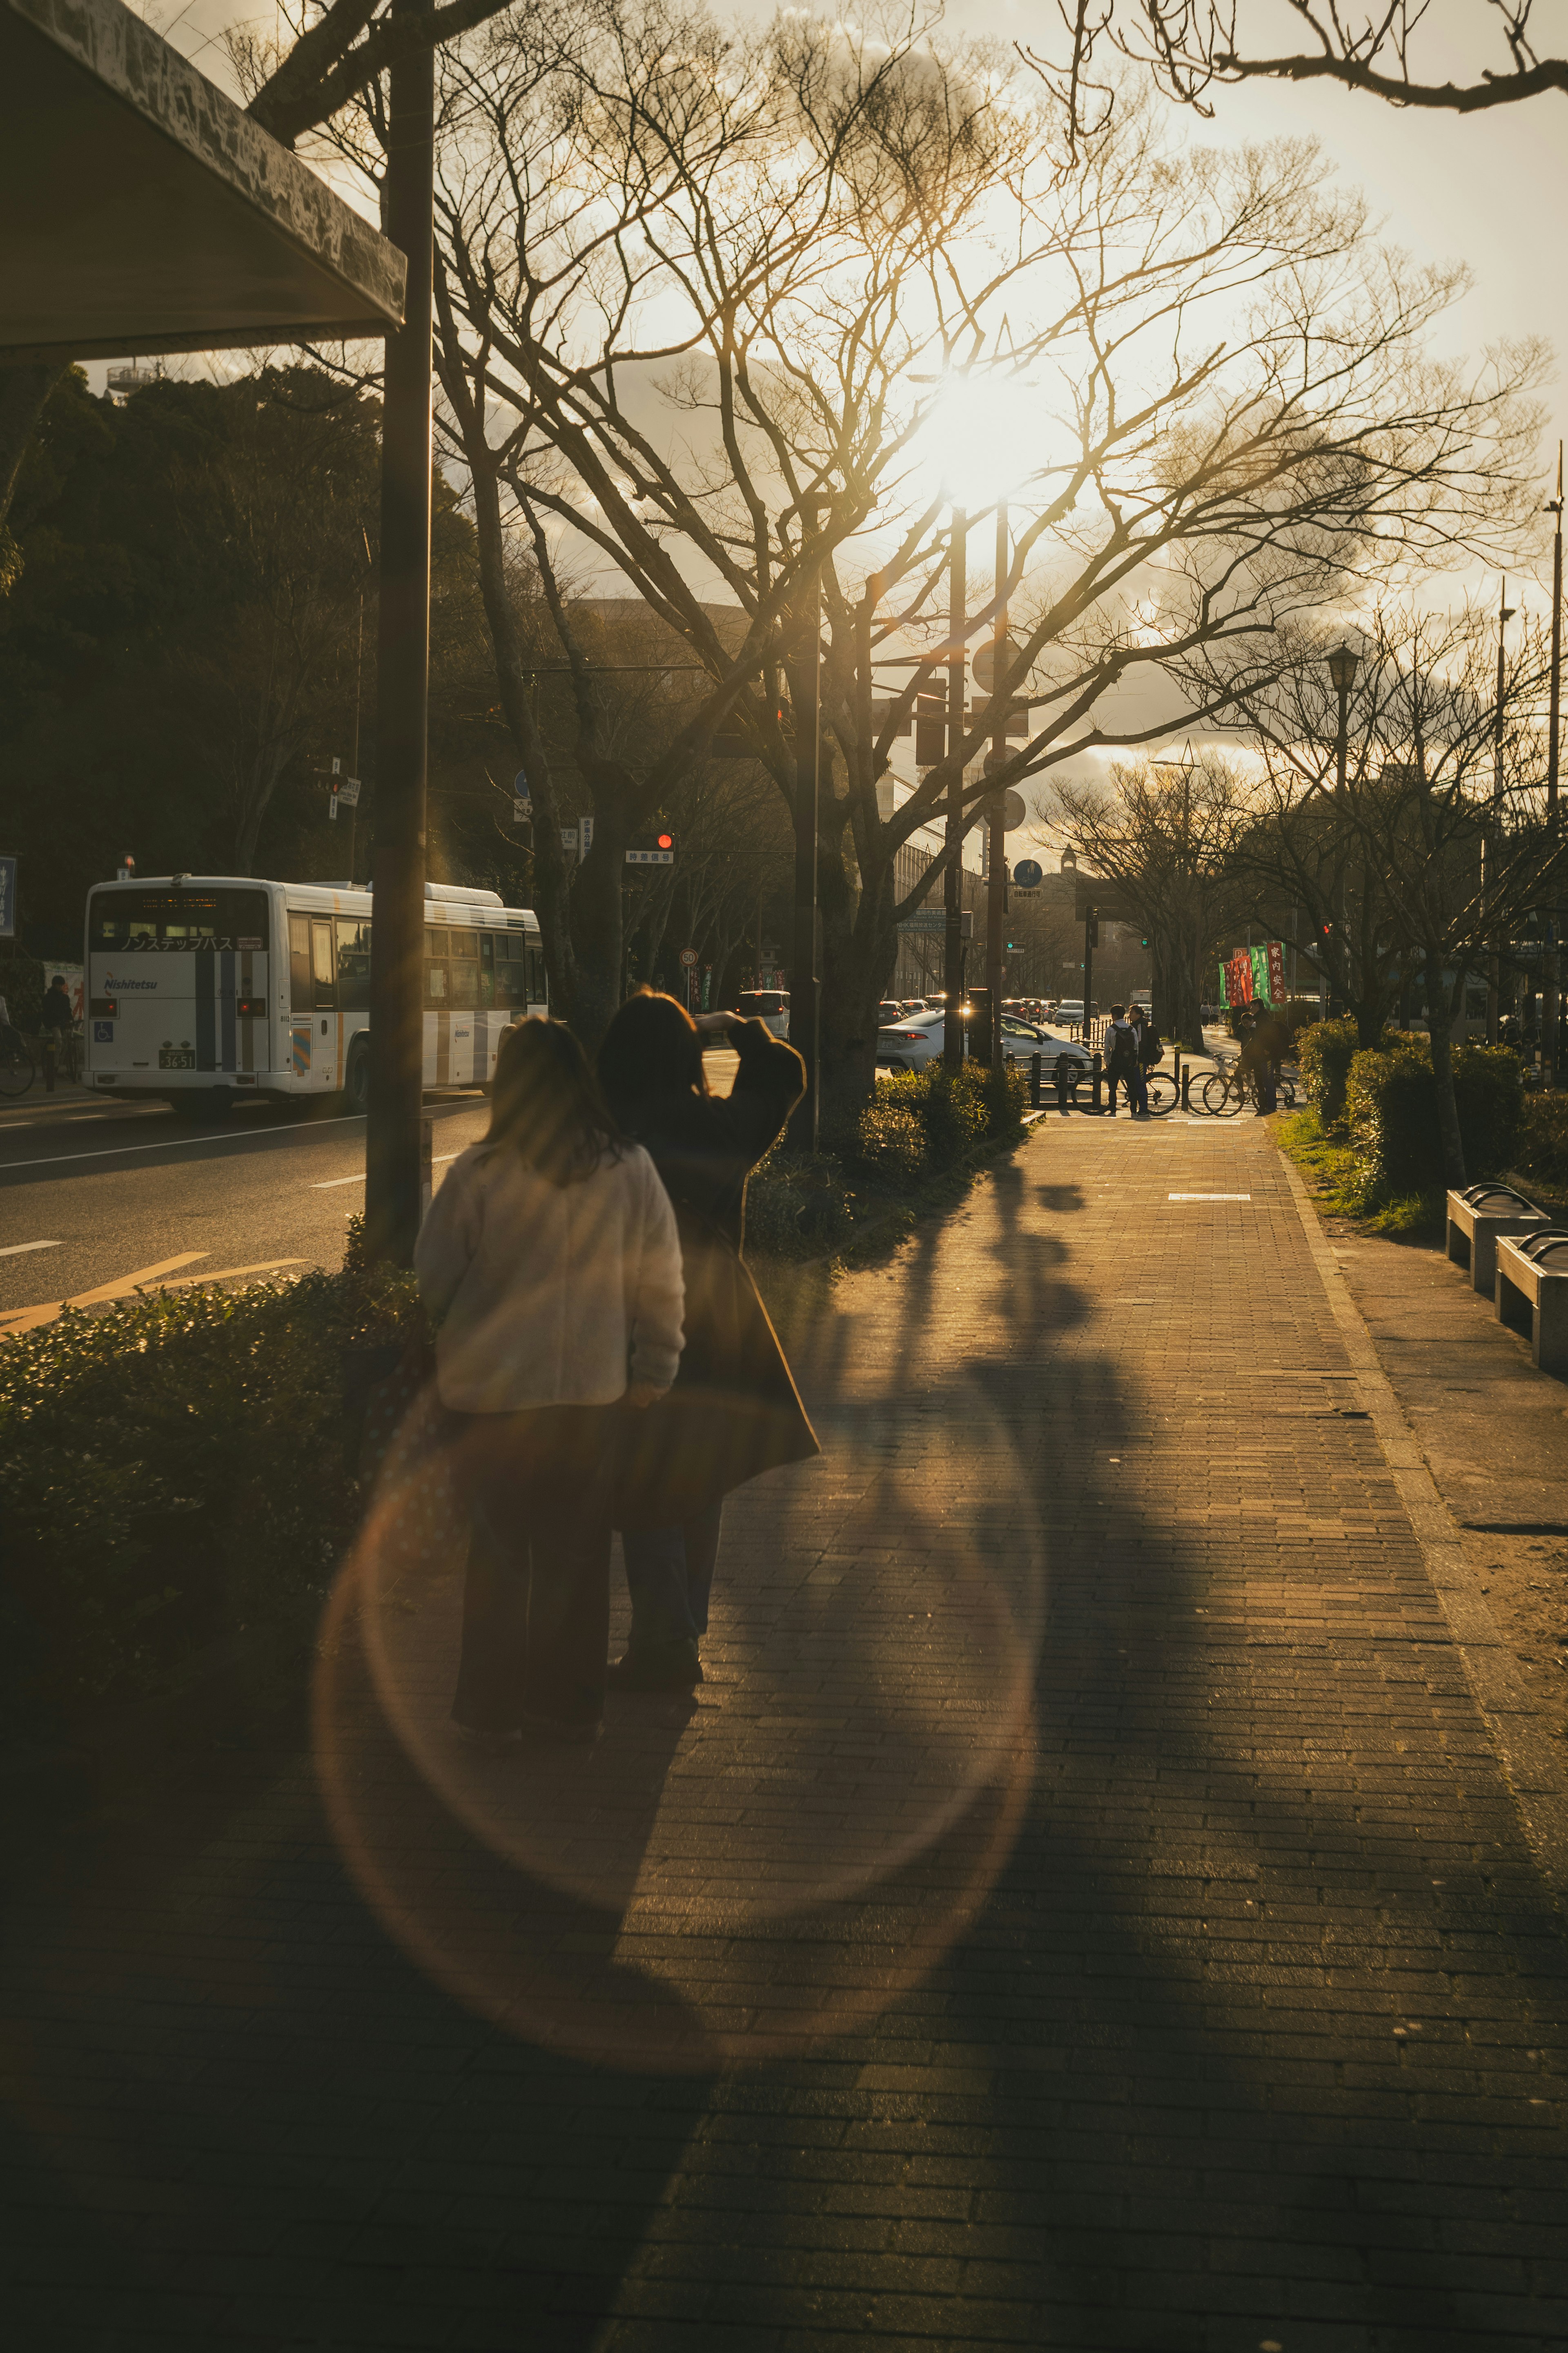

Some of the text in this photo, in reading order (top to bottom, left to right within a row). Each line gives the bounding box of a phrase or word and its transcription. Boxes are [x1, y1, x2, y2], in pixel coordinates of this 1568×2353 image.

[630, 853, 670, 861] 時差信号
[121, 937, 233, 950] ノンステップバス
[1271, 947, 1283, 999] 家内安全
[104, 979, 158, 989] Nishitetsu
[165, 1056, 192, 1067] 36-51
